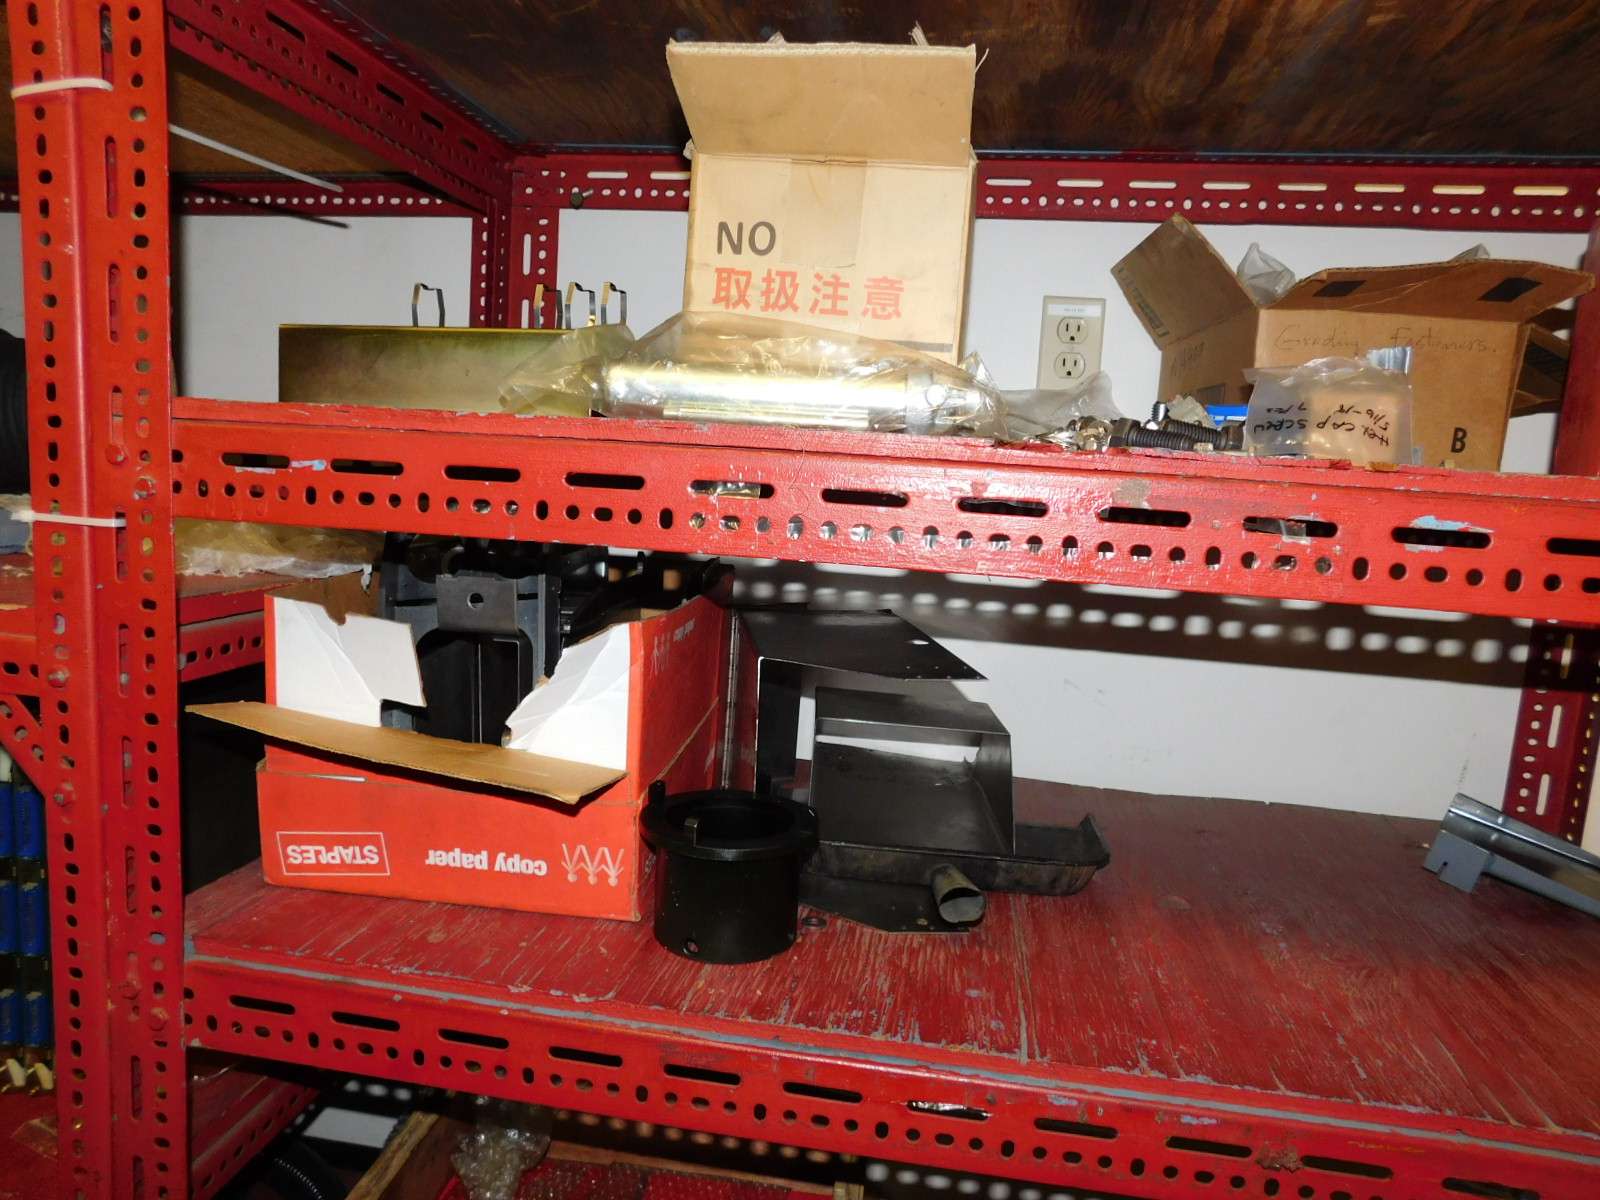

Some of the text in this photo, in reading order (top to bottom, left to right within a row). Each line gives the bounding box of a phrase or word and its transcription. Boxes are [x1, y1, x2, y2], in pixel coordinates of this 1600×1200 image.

[716, 221, 776, 256] NO
[712, 267, 905, 321] 取扱注意
[1450, 427, 1468, 453] B
[286, 845, 380, 865] STAPLES
[425, 849, 548, 876] copy paper
